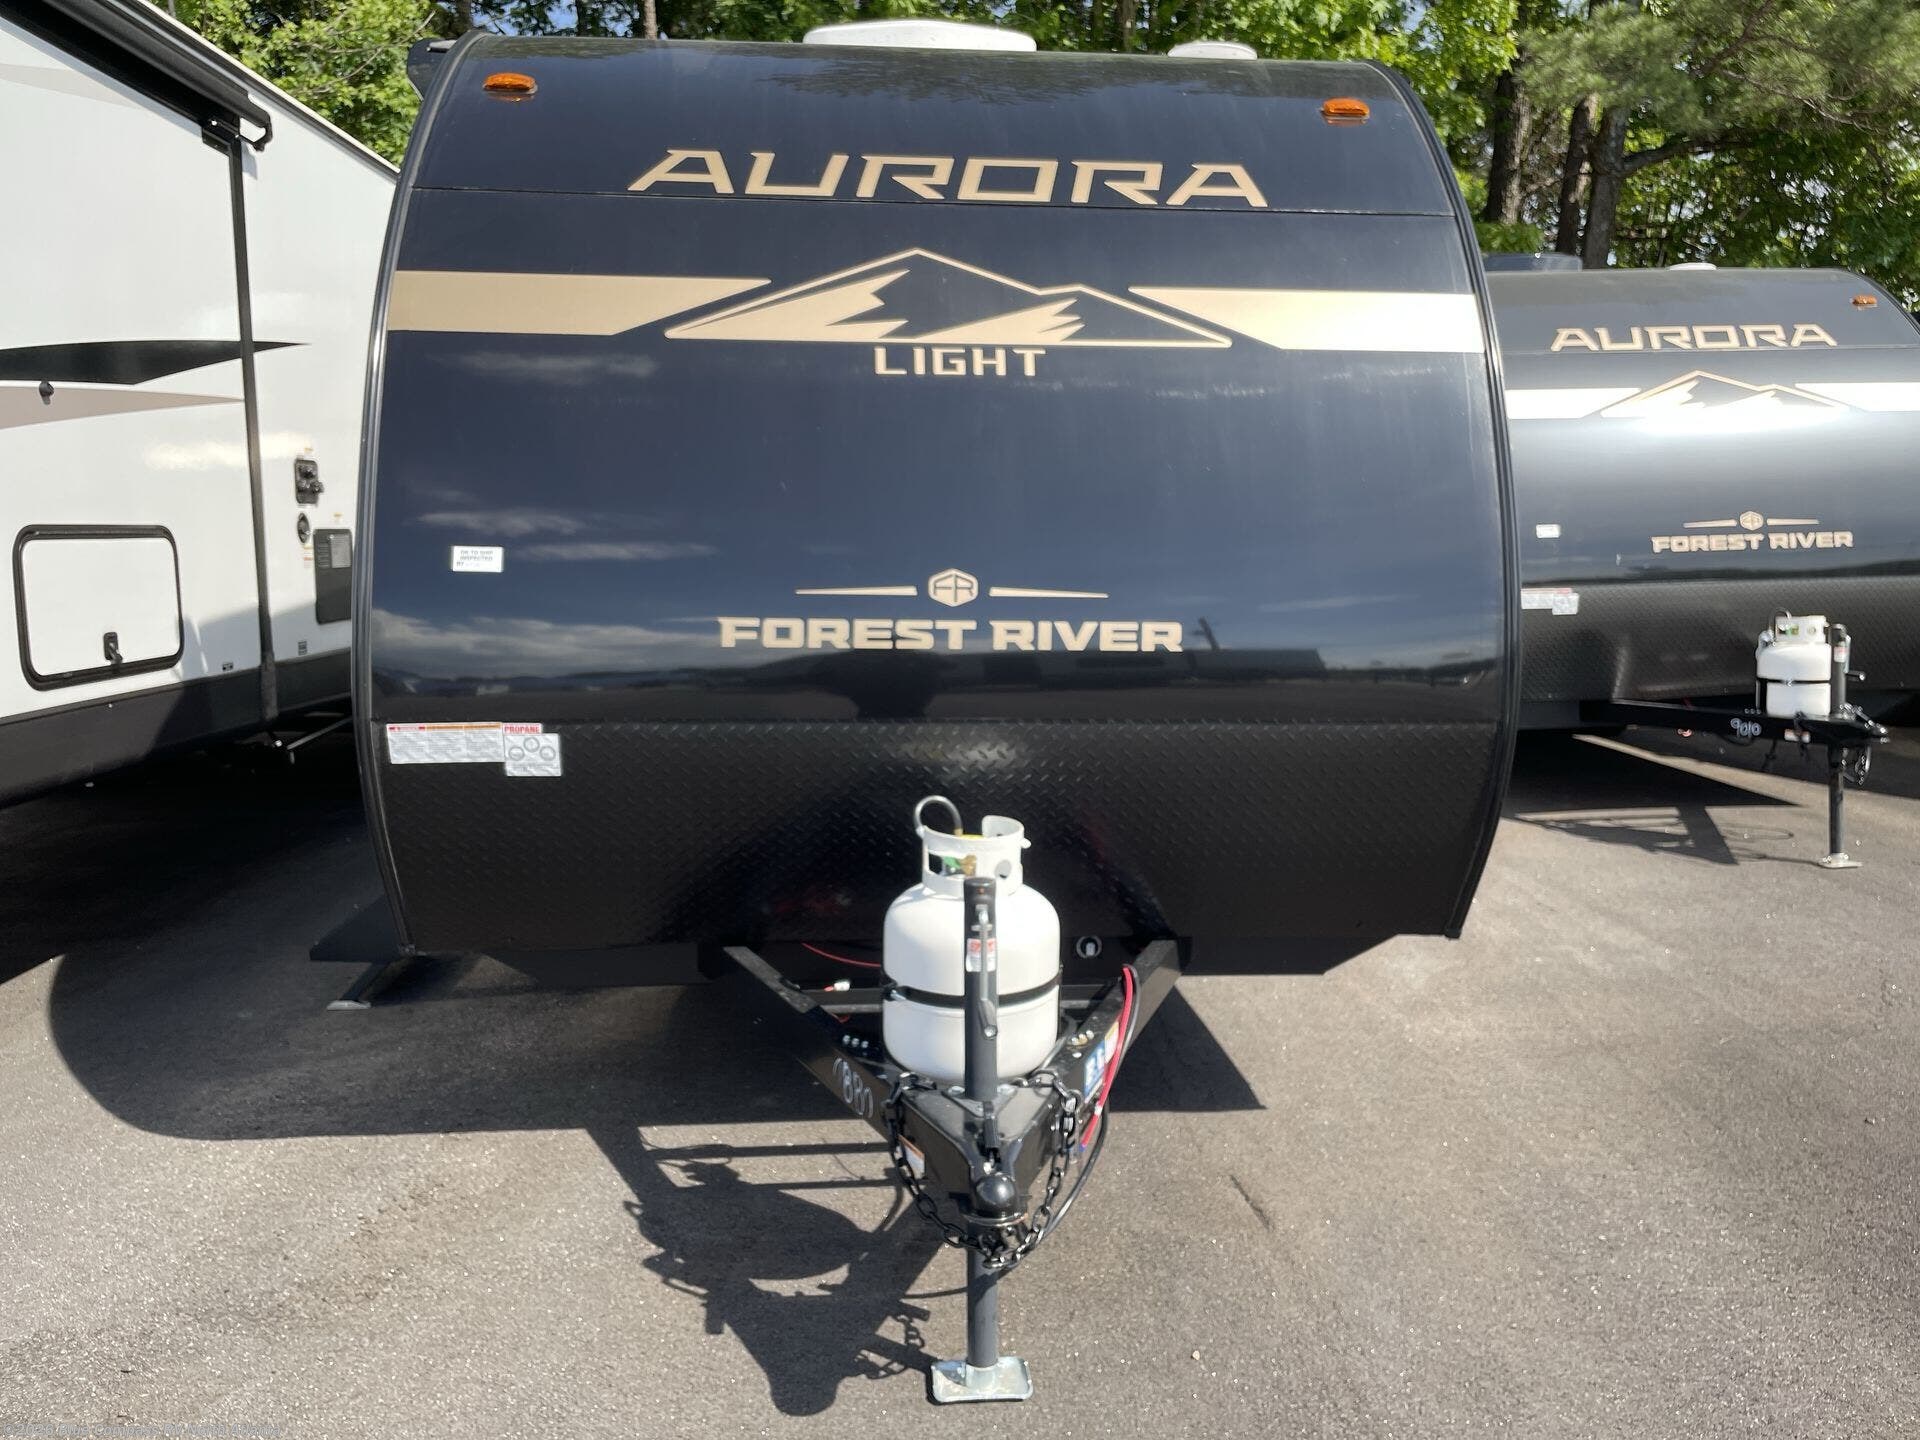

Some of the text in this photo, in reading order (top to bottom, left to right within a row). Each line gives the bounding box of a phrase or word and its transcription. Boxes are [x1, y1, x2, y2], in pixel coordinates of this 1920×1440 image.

[627, 149, 1268, 207] AURORA
[1550, 323, 1838, 351] AURORA
[874, 347, 1047, 376] LIGHT
[1651, 531, 1854, 553] FOREST RIVER
[717, 617, 1184, 652] FOREST RIVER
[504, 725, 540, 734] PROPANE
[1730, 717, 1762, 737] 9010
